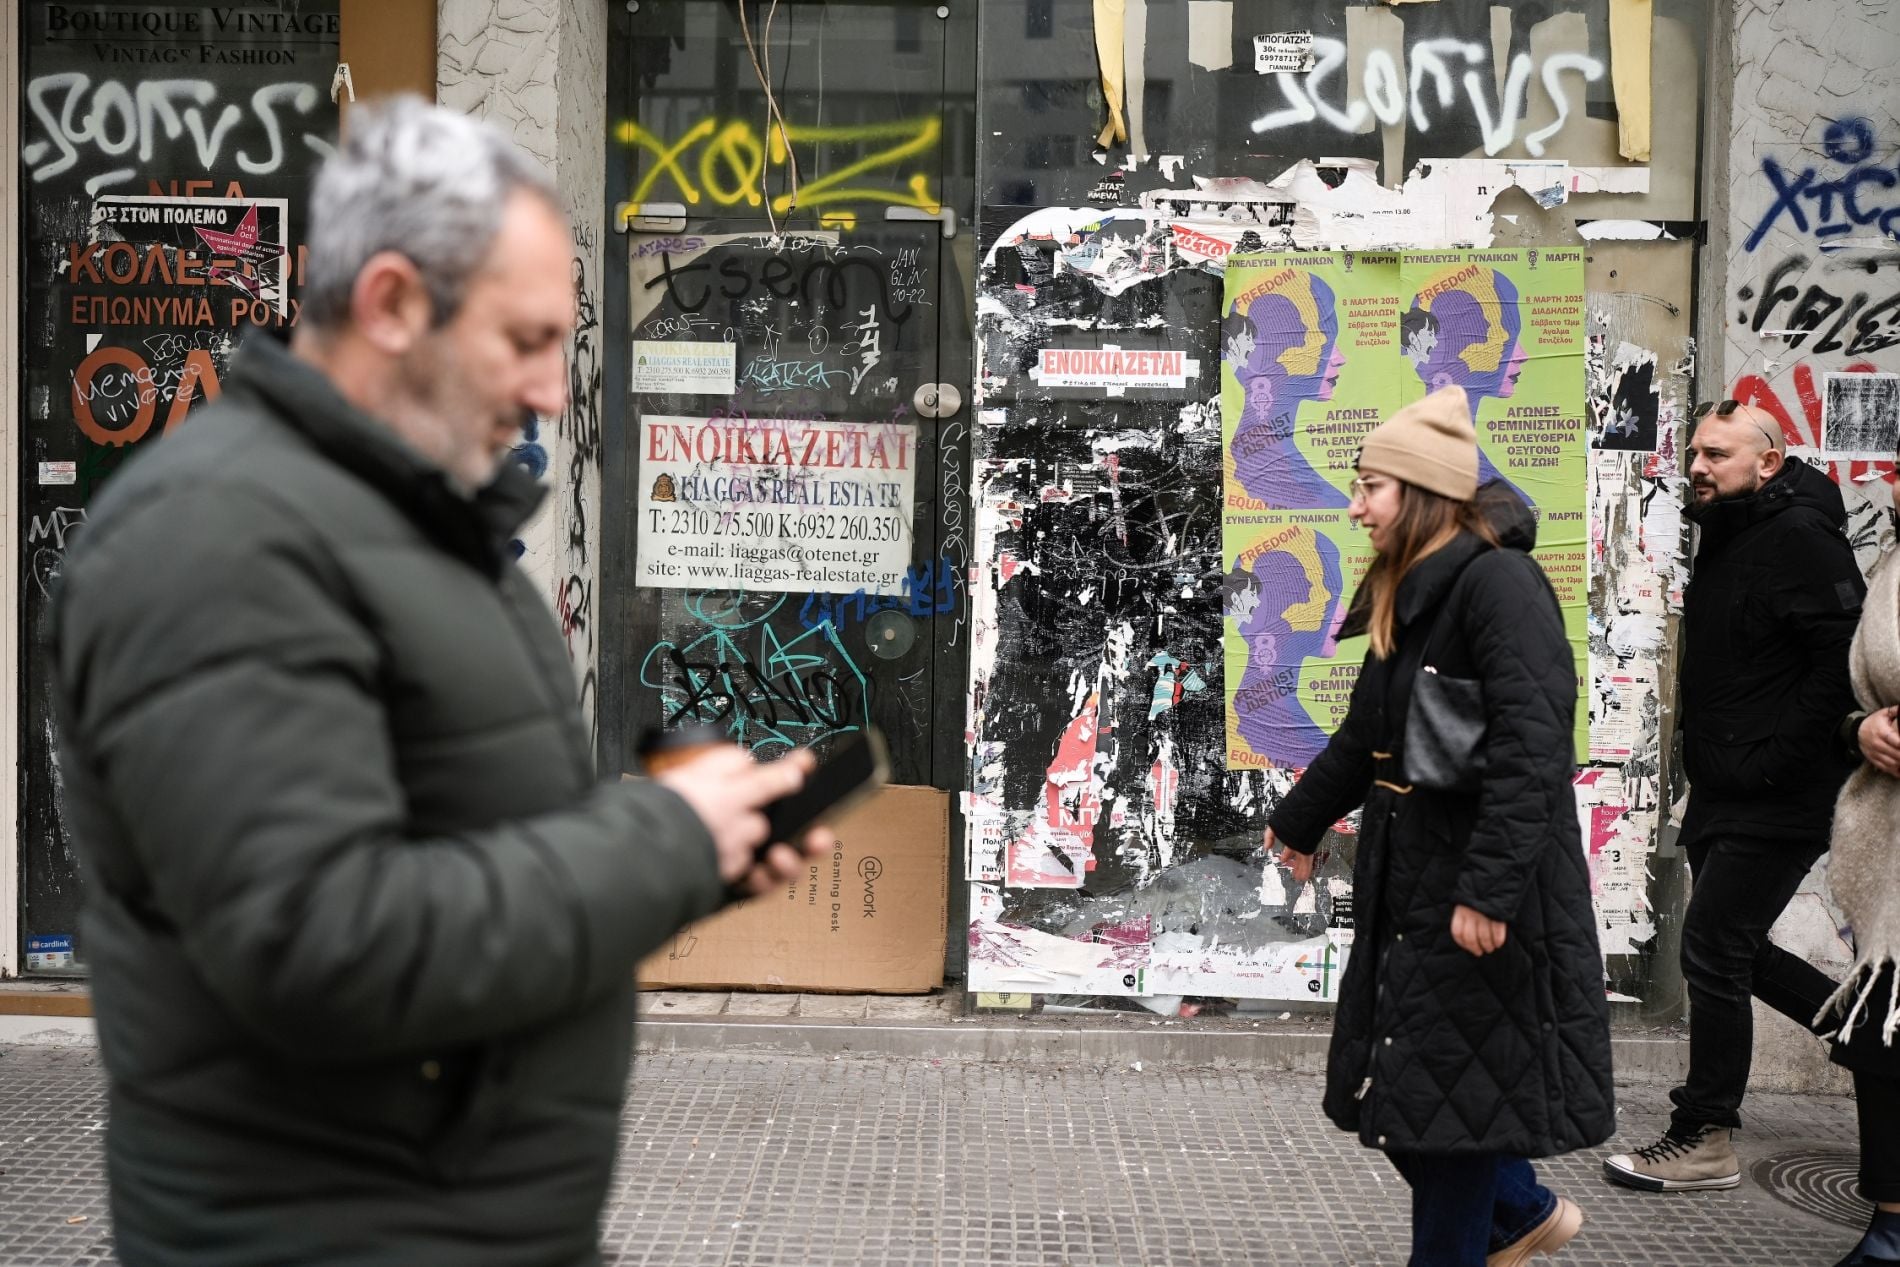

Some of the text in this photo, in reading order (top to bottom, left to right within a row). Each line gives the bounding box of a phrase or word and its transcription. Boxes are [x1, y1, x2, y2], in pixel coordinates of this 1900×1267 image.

[48, 5, 340, 36] BOUTIQUE VINTAGE
[1258, 36, 1311, 44] ΜΠΟΓΙΑΤΖΗΣ
[200, 44, 296, 65] FASHION
[122, 207, 160, 224] ΣΤΟΝ
[164, 208, 228, 225] ΠΟΛΕΜΟ
[69, 240, 311, 287] ΚΟΛΕΞ
[1284, 257, 1334, 266] ΓΥΝΑΙΚΩΝ
[1362, 256, 1397, 265] ΜΑΡΤΗ
[1403, 254, 1460, 263] ΣΥΝΕΛΕΥΣΗ
[1468, 254, 1518, 262] ΓΥΝΑΙΚΩΝ
[1234, 268, 1297, 310] FREEDOM
[1417, 264, 1480, 304] FREEDOM
[72, 296, 214, 326] ΕΠΩΝΥΜΑ
[1531, 319, 1561, 327] Σάββατο
[1538, 336, 1573, 344] Βενιζέλου
[1044, 351, 1182, 376] ΕΝΟΙΚΙΑΖΕΤΑΙ
[1326, 408, 1378, 421] ΑΓΩΝΕΣ
[1507, 406, 1560, 417] ΑΓΩΝΕΣ
[1230, 412, 1292, 450] FEMINIST
[1306, 422, 1384, 435] ΦΕΜΙΝΙΣΤΙ
[1487, 419, 1581, 431] ΦΕΜΙΝΙΣΤΙΚΟΙ
[1241, 426, 1292, 458] JUSTICE
[1311, 437, 1328, 446] ΓΙΑ
[1492, 433, 1576, 443] ΓΙΑ ΕΛΕΥΘΕΡΙΑ
[646, 424, 909, 470] ΕΝΟΙΚΙΑΖΕΤΑΙ
[1327, 449, 1356, 458] ΟΞΥΓ
[1507, 445, 1560, 455] ΟΞΥΓΟΝΟ
[1329, 461, 1348, 470] ΚΑΙ
[1509, 458, 1559, 467] ΚΑΙ ΖΩΗ!
[680, 476, 901, 508] LIAGGAS REAL ESTATE
[1225, 514, 1339, 525] ΣΥΝΕΛΕΥΣΗ ΓΥΝΑΙΚΩΝ
[1548, 512, 1582, 521] ΜΑΡΤΗ
[650, 510, 901, 542] T: 2310 275.500 K:6932 260.350
[1239, 525, 1301, 566] FREEDOM
[668, 542, 880, 566] e-mail: liaggas@otenet.gr
[647, 564, 899, 588] site: www.liaggas-realestate.gr
[1330, 666, 1362, 677] ΑΓΩΝ
[1235, 668, 1296, 704] FEMINIST
[1243, 682, 1296, 714] JUSTICE
[1314, 694, 1331, 702] ΓΙΑ
[1332, 718, 1342, 726] ΚΑ
[788, 876, 800, 900] hite
[809, 866, 818, 906] DK Mini
[830, 840, 844, 932] @Gaming Desk
[40, 940, 69, 948] cardlink
